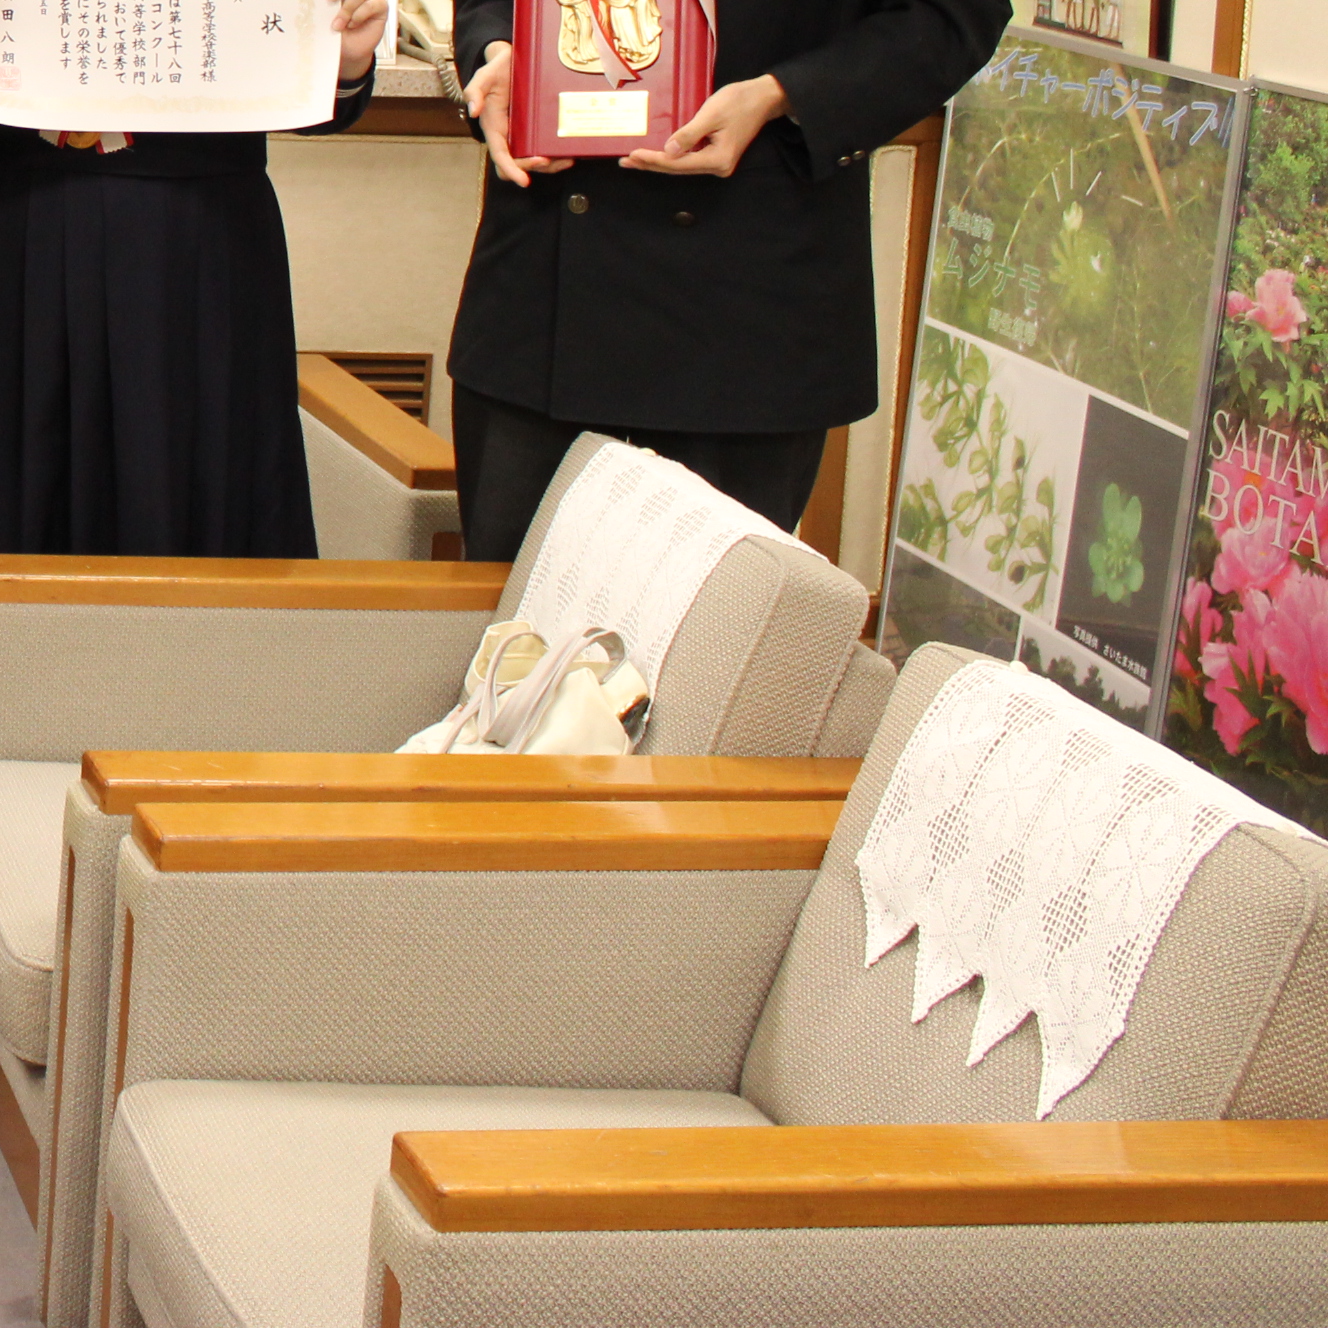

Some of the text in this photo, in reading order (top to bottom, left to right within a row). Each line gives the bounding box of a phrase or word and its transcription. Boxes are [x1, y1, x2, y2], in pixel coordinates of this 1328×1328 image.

[972, 48, 1220, 147] イチャーポジティブ
[942, 237, 1042, 311] ムジナモ
